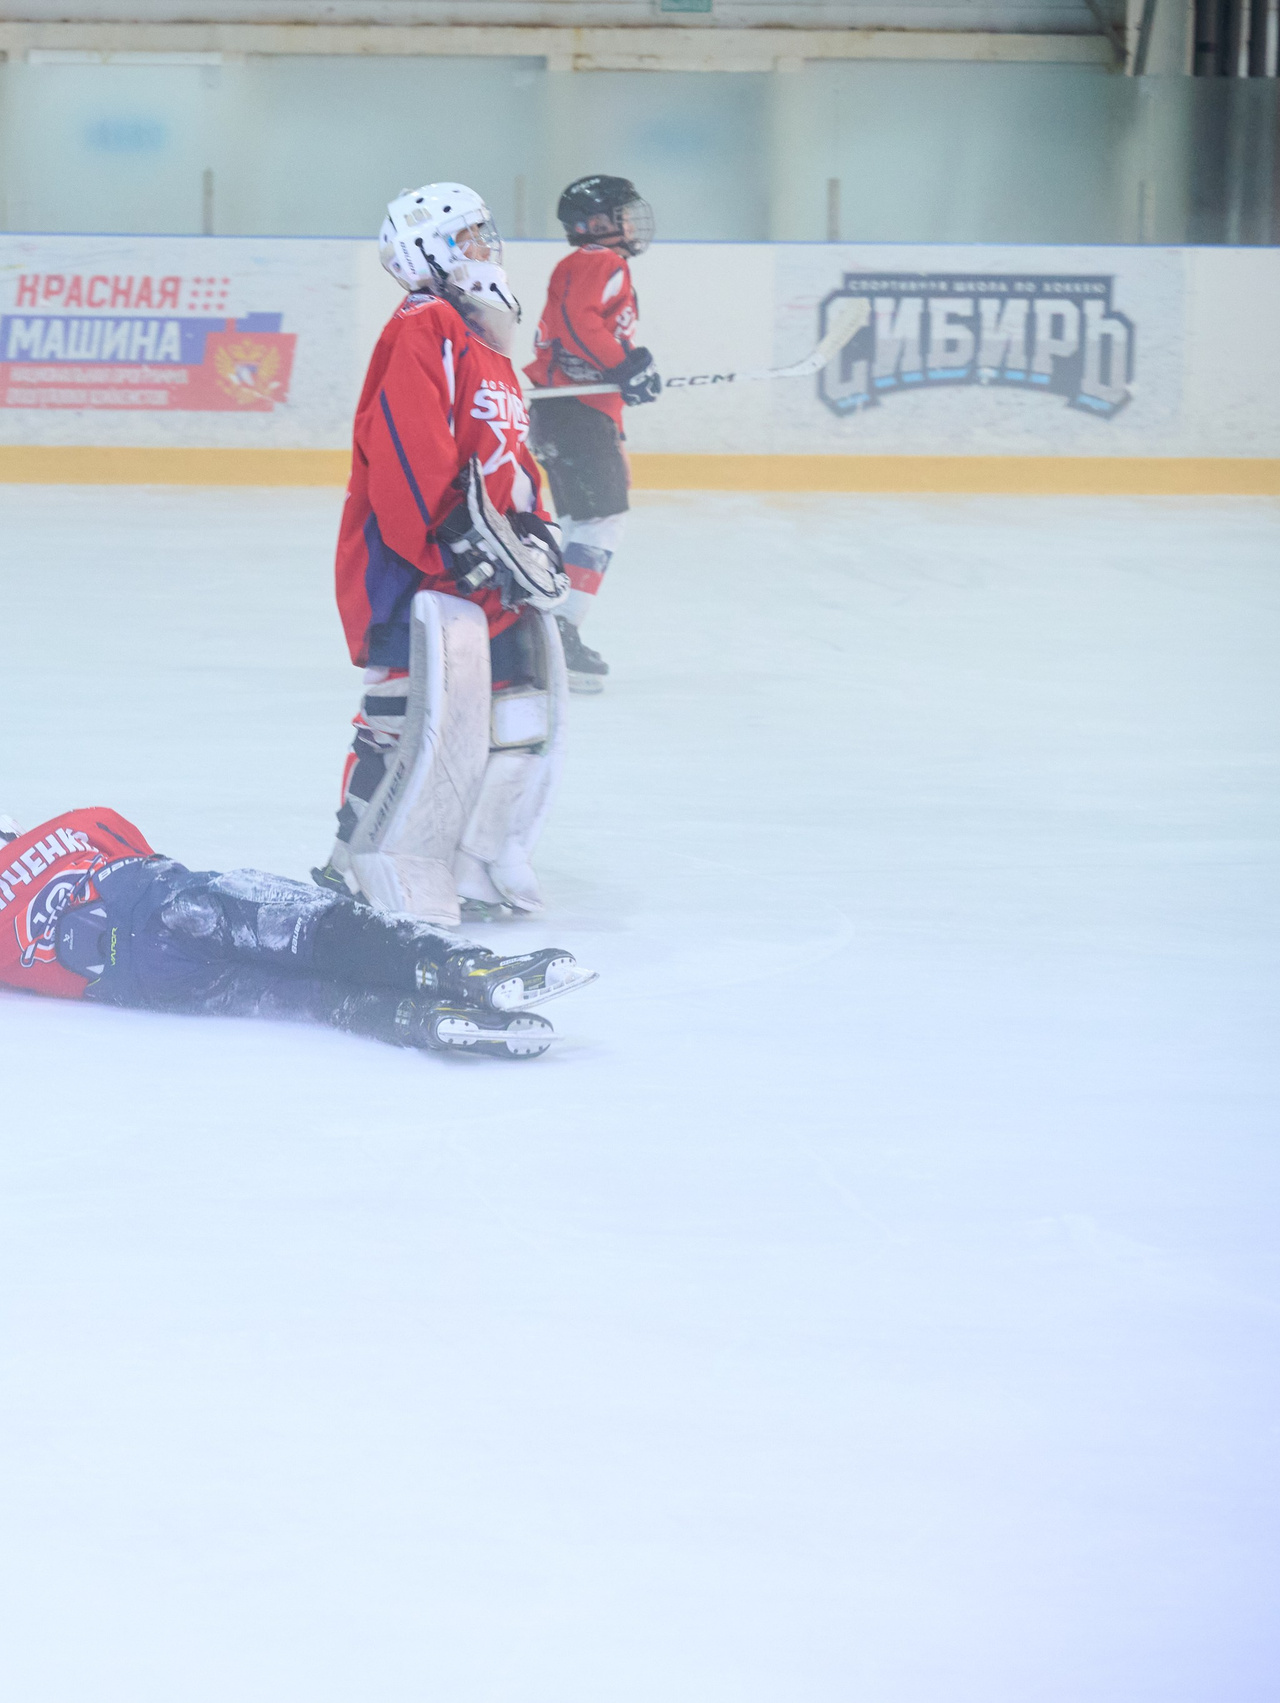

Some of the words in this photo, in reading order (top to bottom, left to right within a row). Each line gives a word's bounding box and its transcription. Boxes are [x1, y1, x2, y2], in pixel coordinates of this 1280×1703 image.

[15, 274, 182, 310] КРАСНАЯ
[5, 317, 182, 362] МАШИНА
[665, 372, 737, 388] CCM
[110, 926, 118, 966] VAPOR
[291, 916, 302, 955] BAUER
